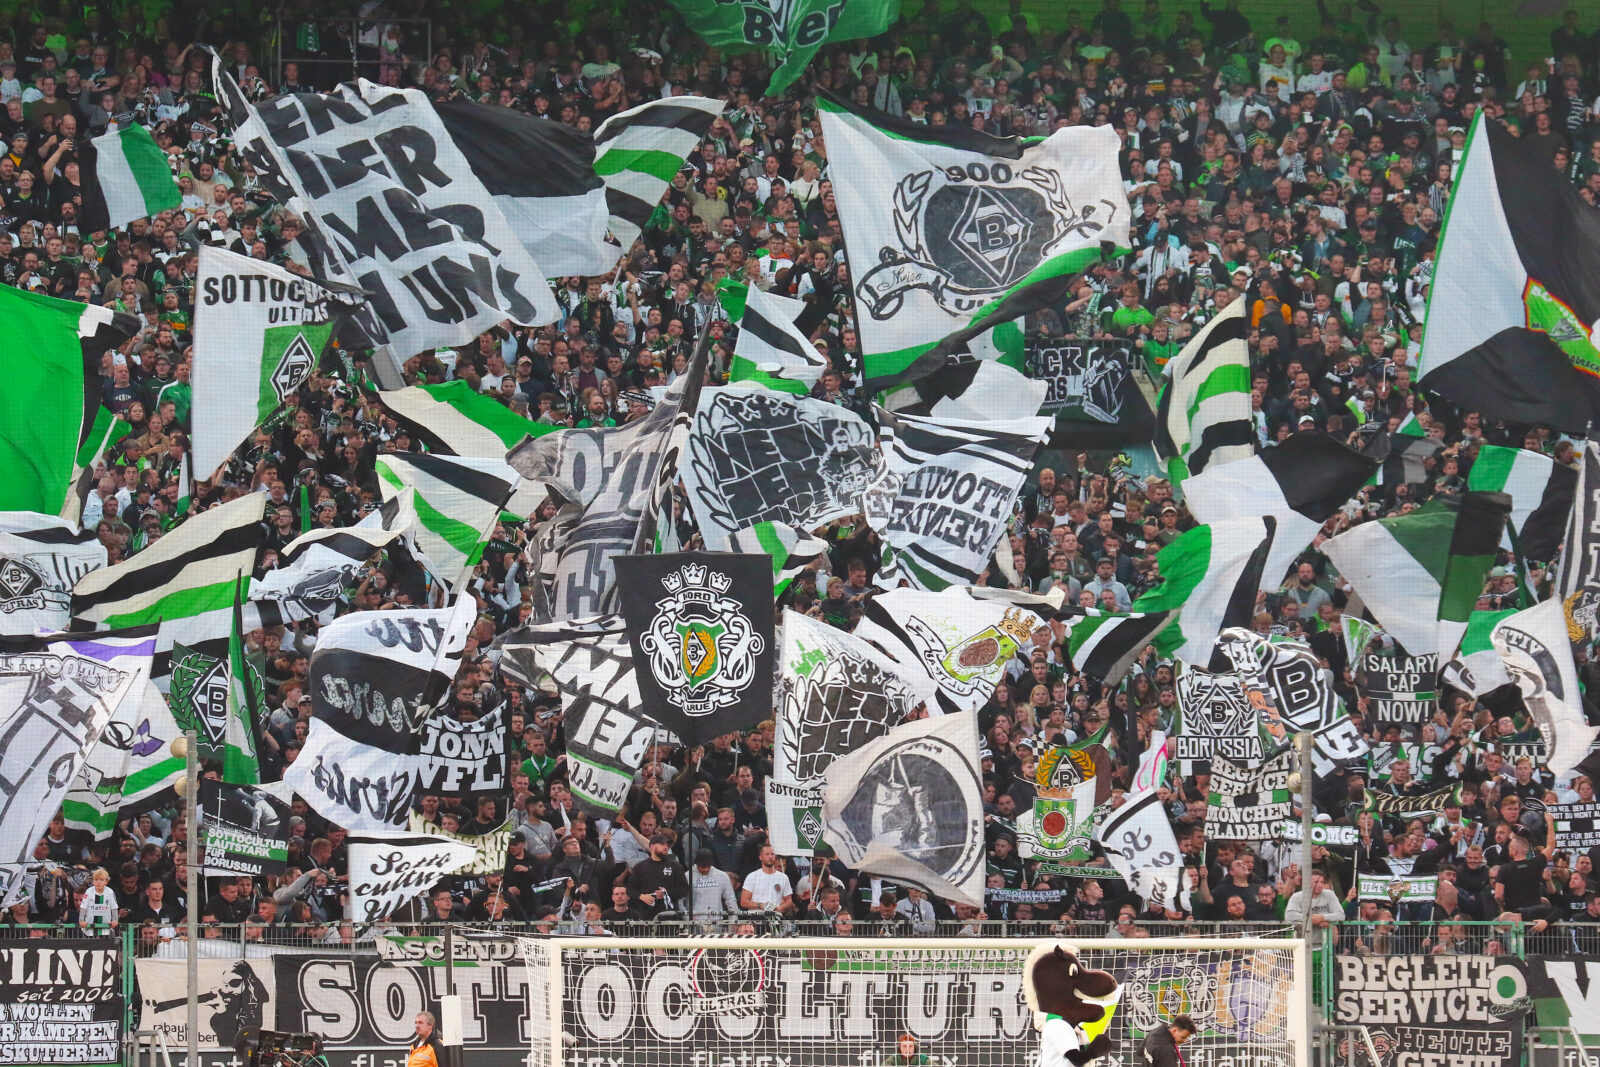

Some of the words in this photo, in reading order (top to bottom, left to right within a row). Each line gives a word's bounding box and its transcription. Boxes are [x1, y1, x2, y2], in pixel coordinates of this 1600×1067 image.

[1368, 653, 1438, 673] SALARY
[1387, 673, 1420, 692] CAP
[1377, 700, 1429, 722] NOW!
[1177, 736, 1262, 758] BORUSSIA
[1209, 772, 1289, 796] SERVICE
[1206, 802, 1292, 823] MÖNCHEN
[1204, 821, 1291, 841] GLADBAC
[206, 837, 271, 858] LAUTSTARK
[204, 856, 263, 875] BORUSSIA!
[1337, 955, 1495, 990] BEGLEIT
[17, 984, 54, 1003] seit
[62, 986, 114, 1003] 2006
[11, 1003, 96, 1023] WOLLEN
[699, 997, 756, 1012] ULTRAS
[1336, 988, 1490, 1024] SERVICE
[18, 1022, 119, 1044] KÄMPFEN
[177, 1032, 219, 1043] blben
[1396, 1027, 1512, 1059] HEUTE
